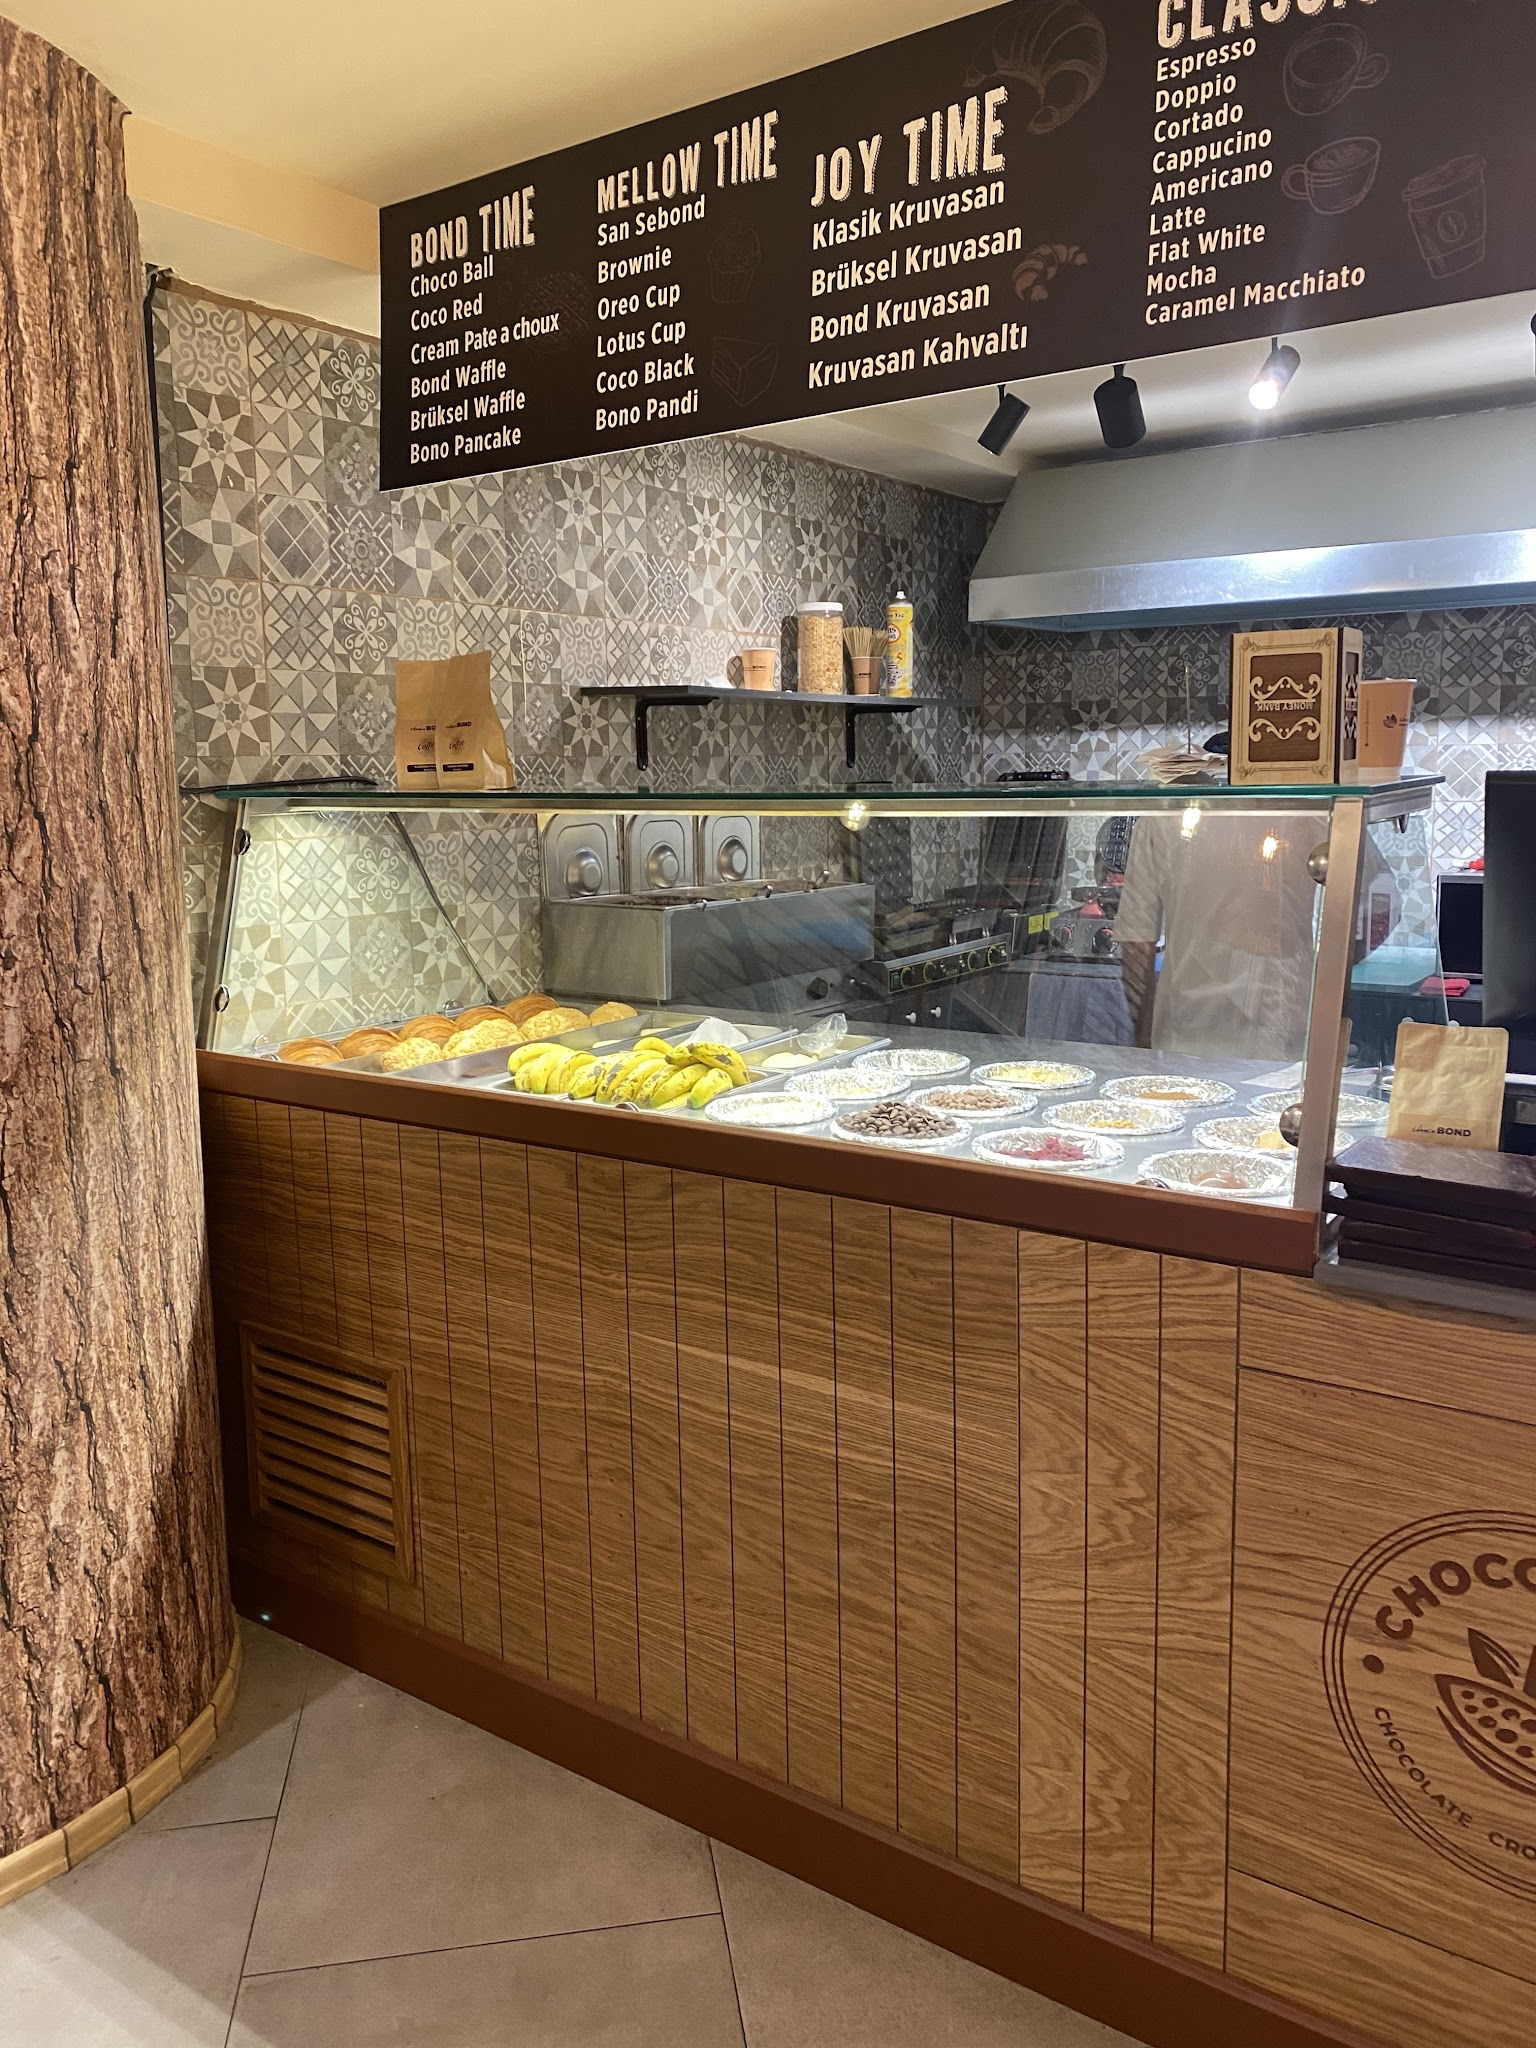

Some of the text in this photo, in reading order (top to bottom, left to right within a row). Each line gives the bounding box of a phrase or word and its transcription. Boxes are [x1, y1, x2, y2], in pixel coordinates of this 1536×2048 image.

[1156, 37, 1257, 82] Espresso
[1155, 73, 1237, 113] Doppio
[1153, 102, 1244, 143] Cortado
[597, 109, 779, 214] MELLOW TIME
[810, 85, 1009, 208] JOY TIME
[1152, 127, 1273, 174] Cappucino
[1149, 159, 1273, 206] Americano
[410, 184, 536, 269] BOND TIME
[597, 193, 706, 247] San Sebond
[812, 180, 1005, 251] Klasik Kruvasan
[1149, 205, 1206, 236] Latte
[598, 245, 672, 284] Brownie
[811, 226, 1022, 297] Brüksel Kruvasan
[1148, 223, 1266, 266] Flat White
[410, 254, 494, 298] Choco Ball
[1145, 265, 1366, 326] Caramel Macchiato
[1146, 264, 1217, 297] Mocha
[410, 292, 483, 331] Coco Red
[597, 283, 681, 321] Oreo Cup
[810, 284, 990, 343] Bond Kruvasan
[410, 312, 560, 365] Cream Pate a choux
[597, 320, 686, 358] Lotus Cup
[808, 322, 1028, 390] Kruvasan Kahvaltı
[411, 358, 507, 399] Bond Waffle
[596, 352, 695, 394] Coco Black
[410, 388, 526, 432] Brüksel Waffle
[595, 388, 699, 431] Bono Pandi
[410, 425, 522, 464] Bono Pancake
[1257, 701, 1313, 712] MONEY BANK
[1374, 1706, 1536, 1860] CHOCOLATE CRO
